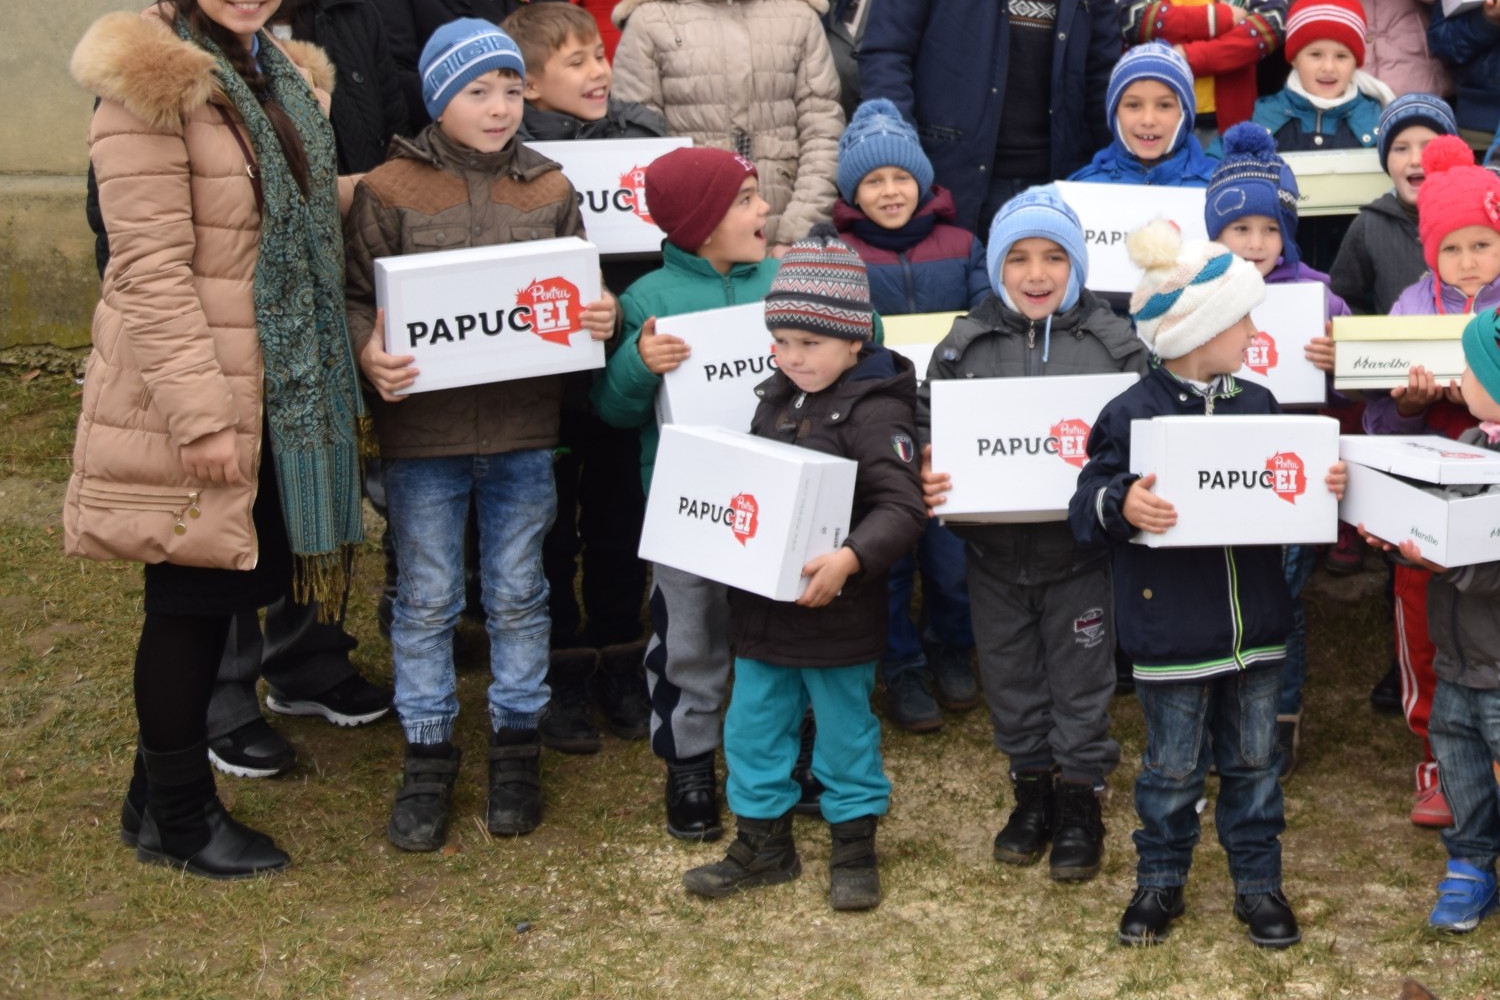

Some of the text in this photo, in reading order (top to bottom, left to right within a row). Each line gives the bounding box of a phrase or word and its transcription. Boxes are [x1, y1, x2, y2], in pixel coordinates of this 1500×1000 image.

[528, 284, 572, 303] Pentru
[1353, 356, 1410, 370] Marelbo
[1410, 527, 1439, 546] Marelbo
